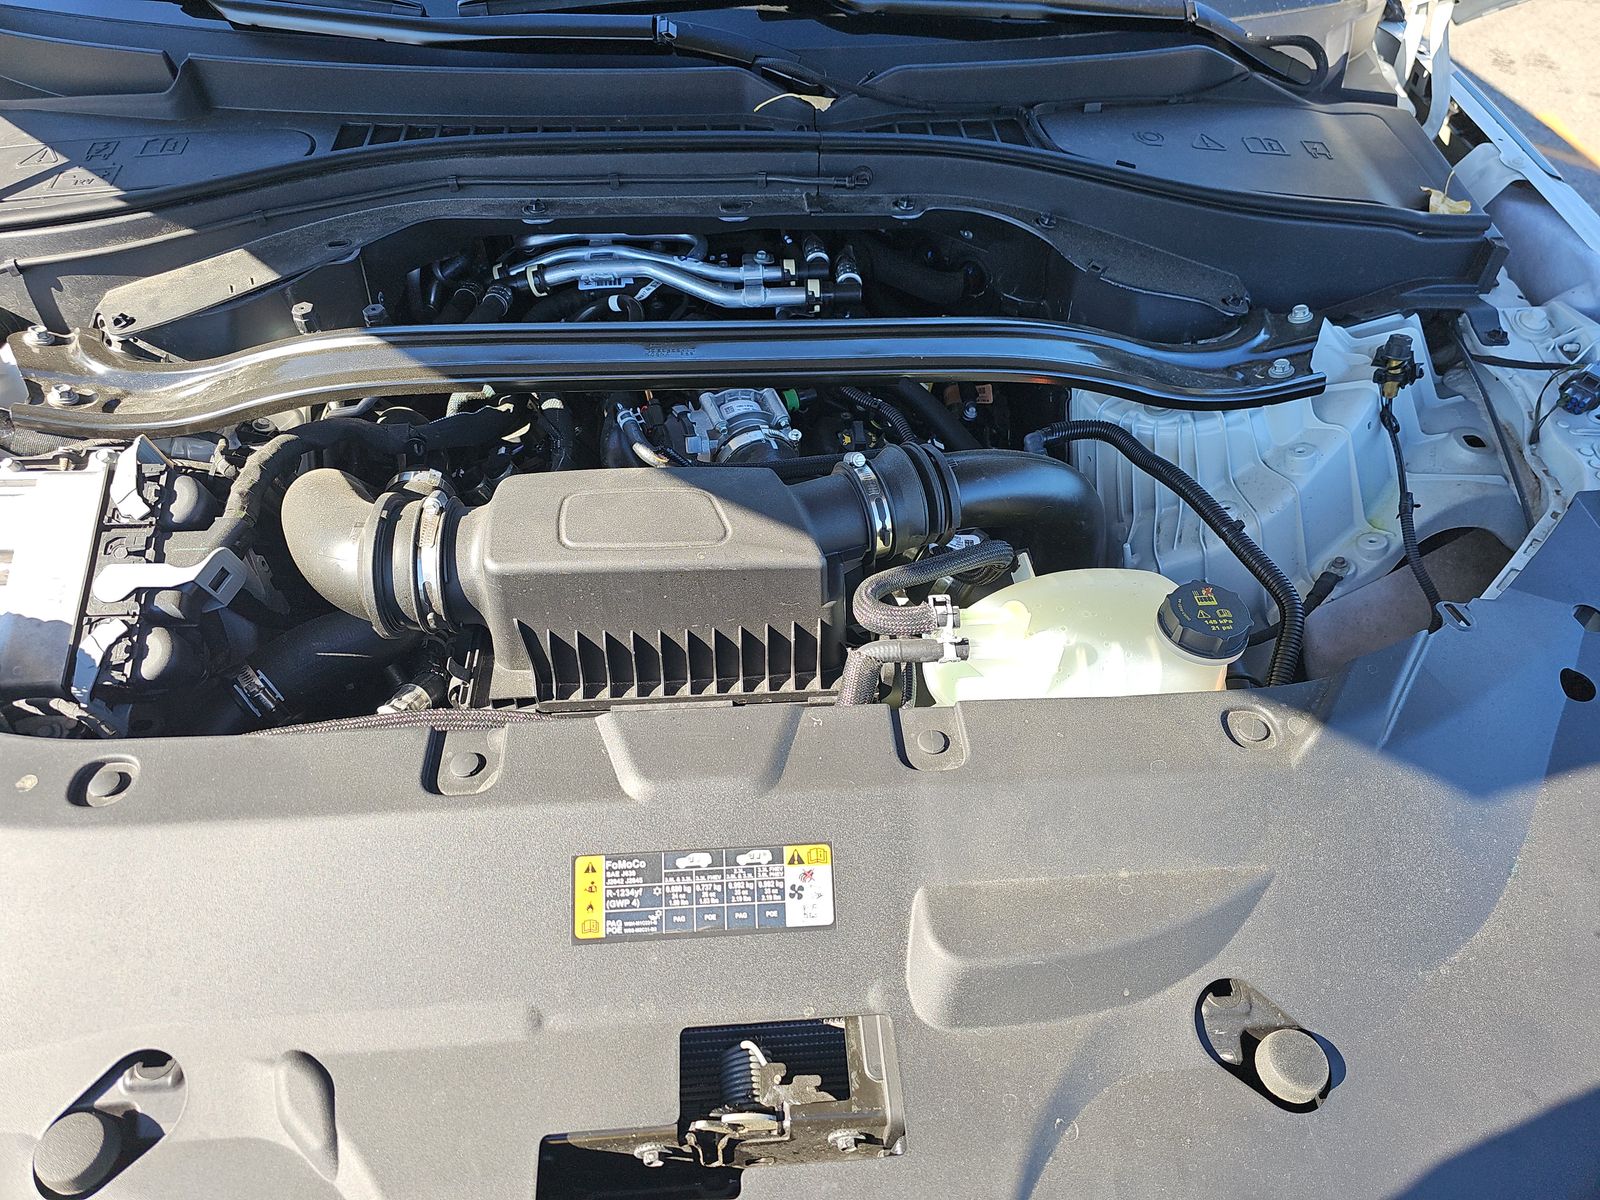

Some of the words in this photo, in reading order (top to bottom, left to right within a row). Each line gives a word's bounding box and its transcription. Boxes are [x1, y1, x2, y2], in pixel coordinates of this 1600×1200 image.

[606, 859, 647, 870] FoMoCo
[713, 883, 722, 892] kg
[745, 881, 754, 890] kg
[775, 880, 784, 888] kg
[606, 887, 643, 898] R-1234yf
[683, 885, 692, 894] kg
[606, 899, 631, 910] (GWP
[631, 898, 640, 908] 4)
[765, 910, 778, 918] POE
[672, 915, 686, 923] PAG
[606, 926, 623, 934] POE
